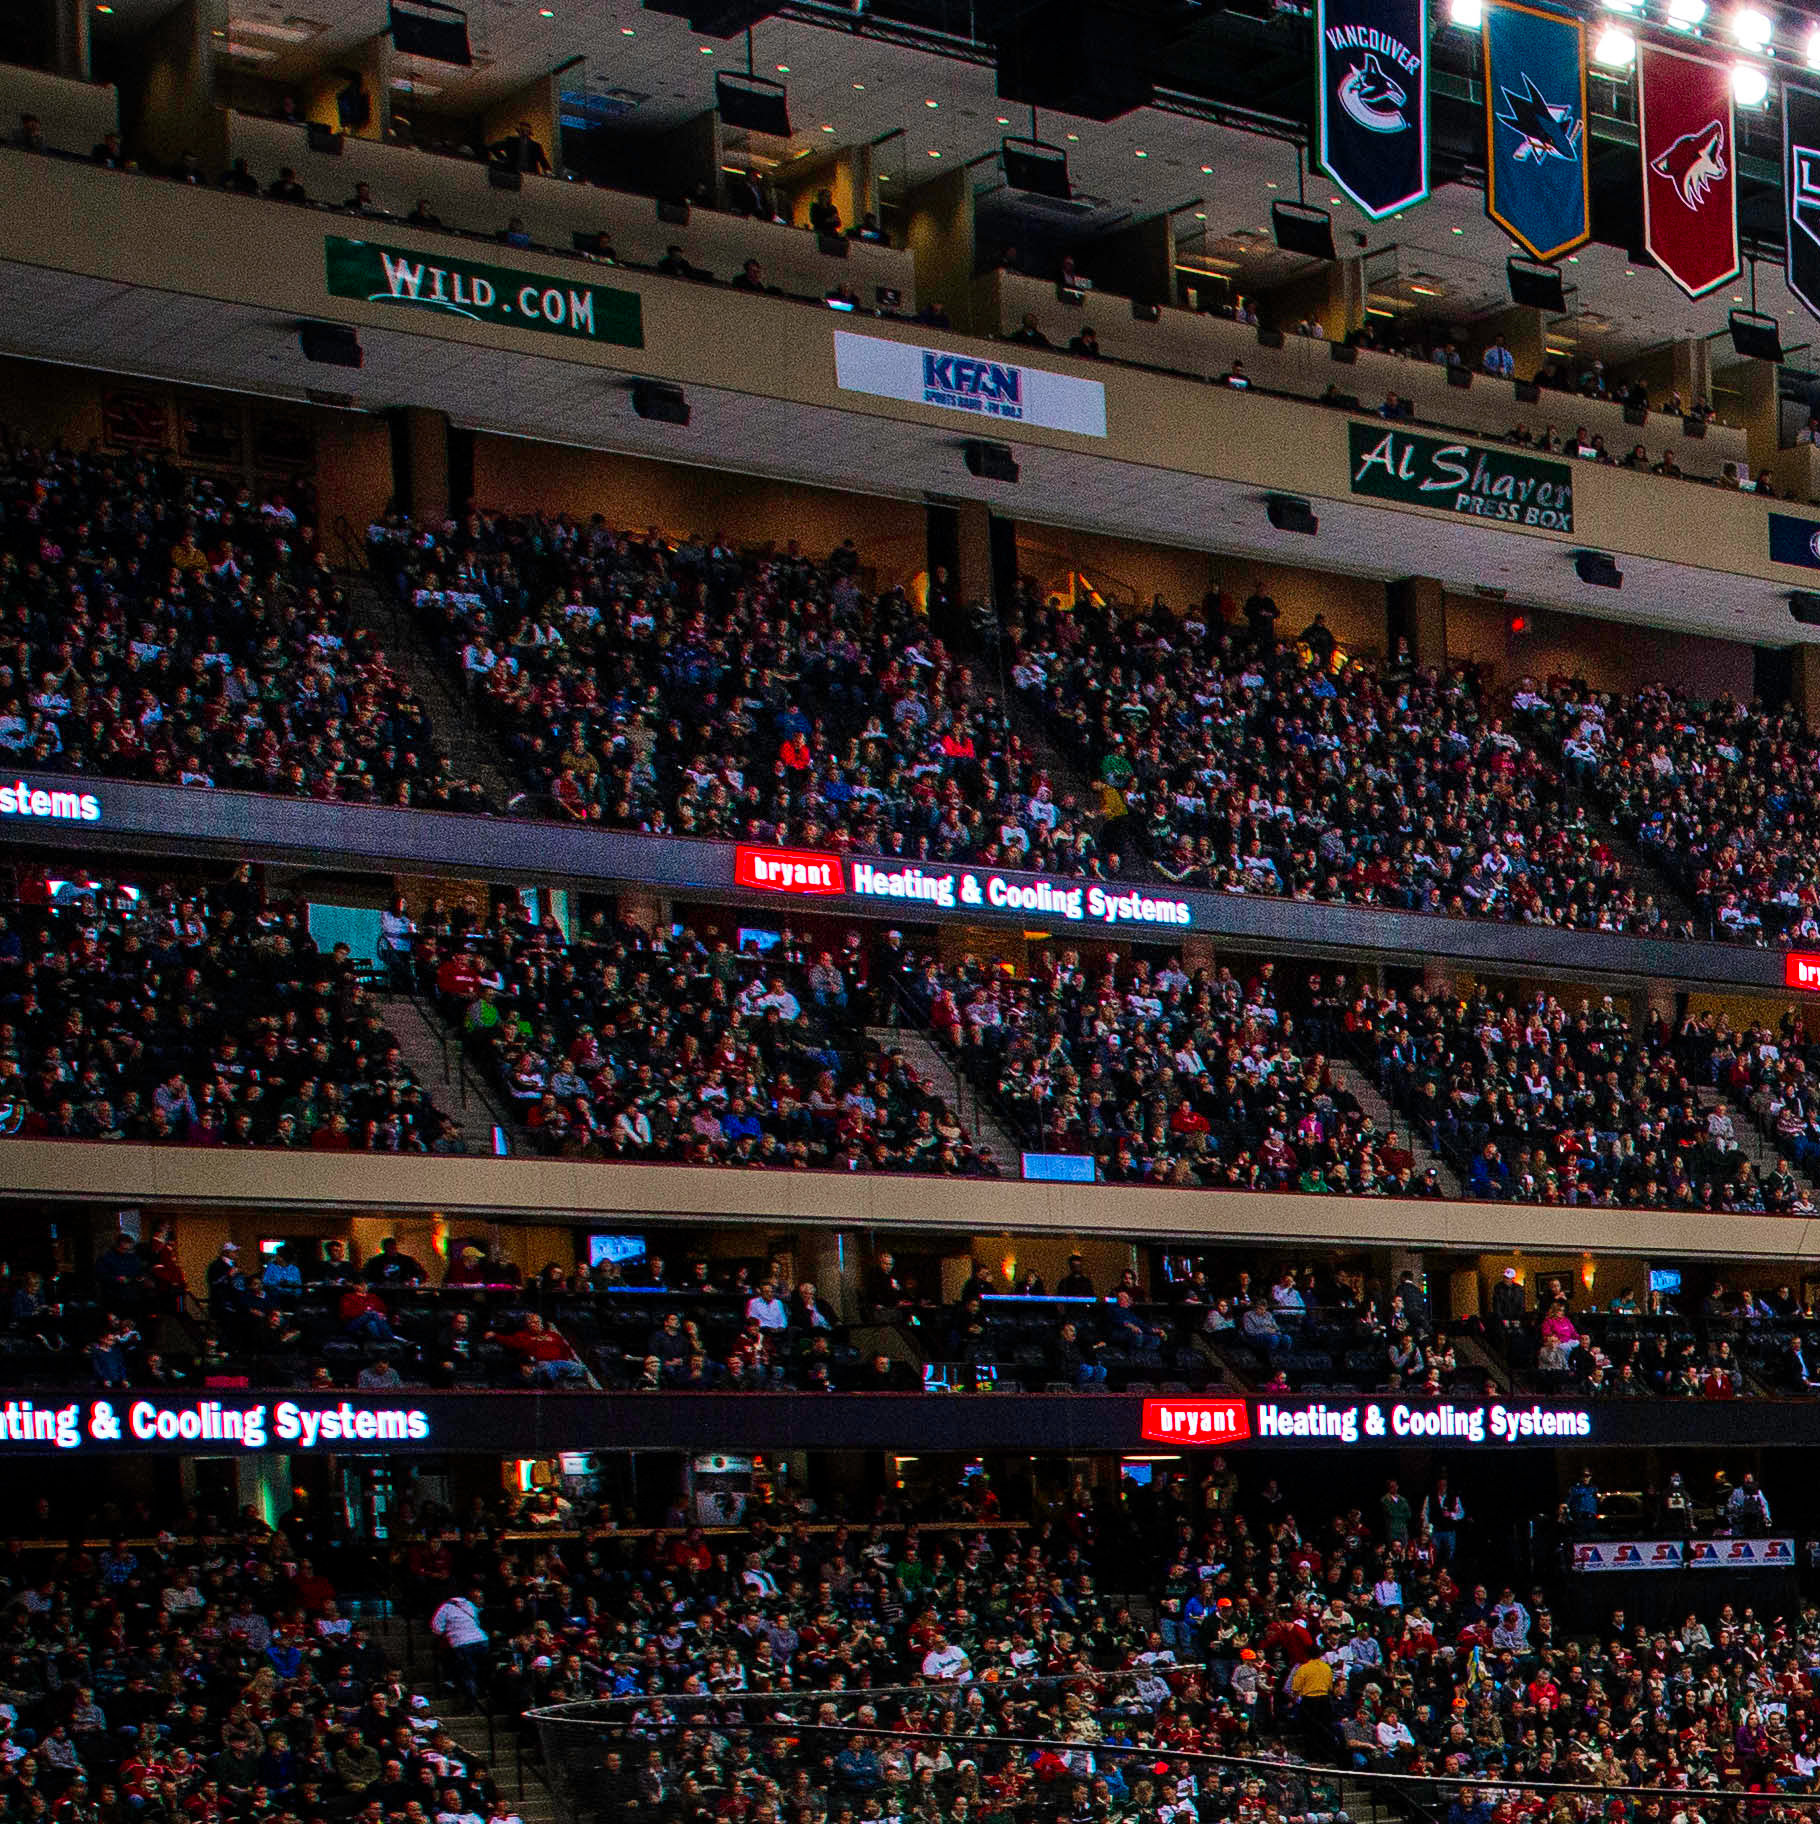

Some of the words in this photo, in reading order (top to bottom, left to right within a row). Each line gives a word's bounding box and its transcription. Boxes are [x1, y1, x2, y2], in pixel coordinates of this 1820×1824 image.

[1325, 24, 1421, 76] VANCOUVER
[380, 252, 596, 336] WILD.COM
[923, 351, 1022, 405] KFAN
[1355, 432, 1415, 481] Al
[1419, 446, 1572, 508] Shaver
[1455, 493, 1520, 523] PRESS
[1524, 506, 1573, 532] BOX
[0, 780, 99, 821] stems
[754, 857, 831, 886] bryant
[852, 863, 954, 907] Heating
[961, 874, 982, 904] &
[989, 877, 1084, 919] Cooling
[1087, 887, 1192, 925] Systems
[90, 1401, 120, 1440] &
[130, 1401, 267, 1448] Cooling
[275, 1401, 430, 1446] Systems
[1160, 1407, 1236, 1437] bryant
[1258, 1404, 1358, 1442] Heating
[1365, 1404, 1386, 1436] &
[1392, 1404, 1485, 1442] Cooling
[1490, 1404, 1591, 1442] Systems
